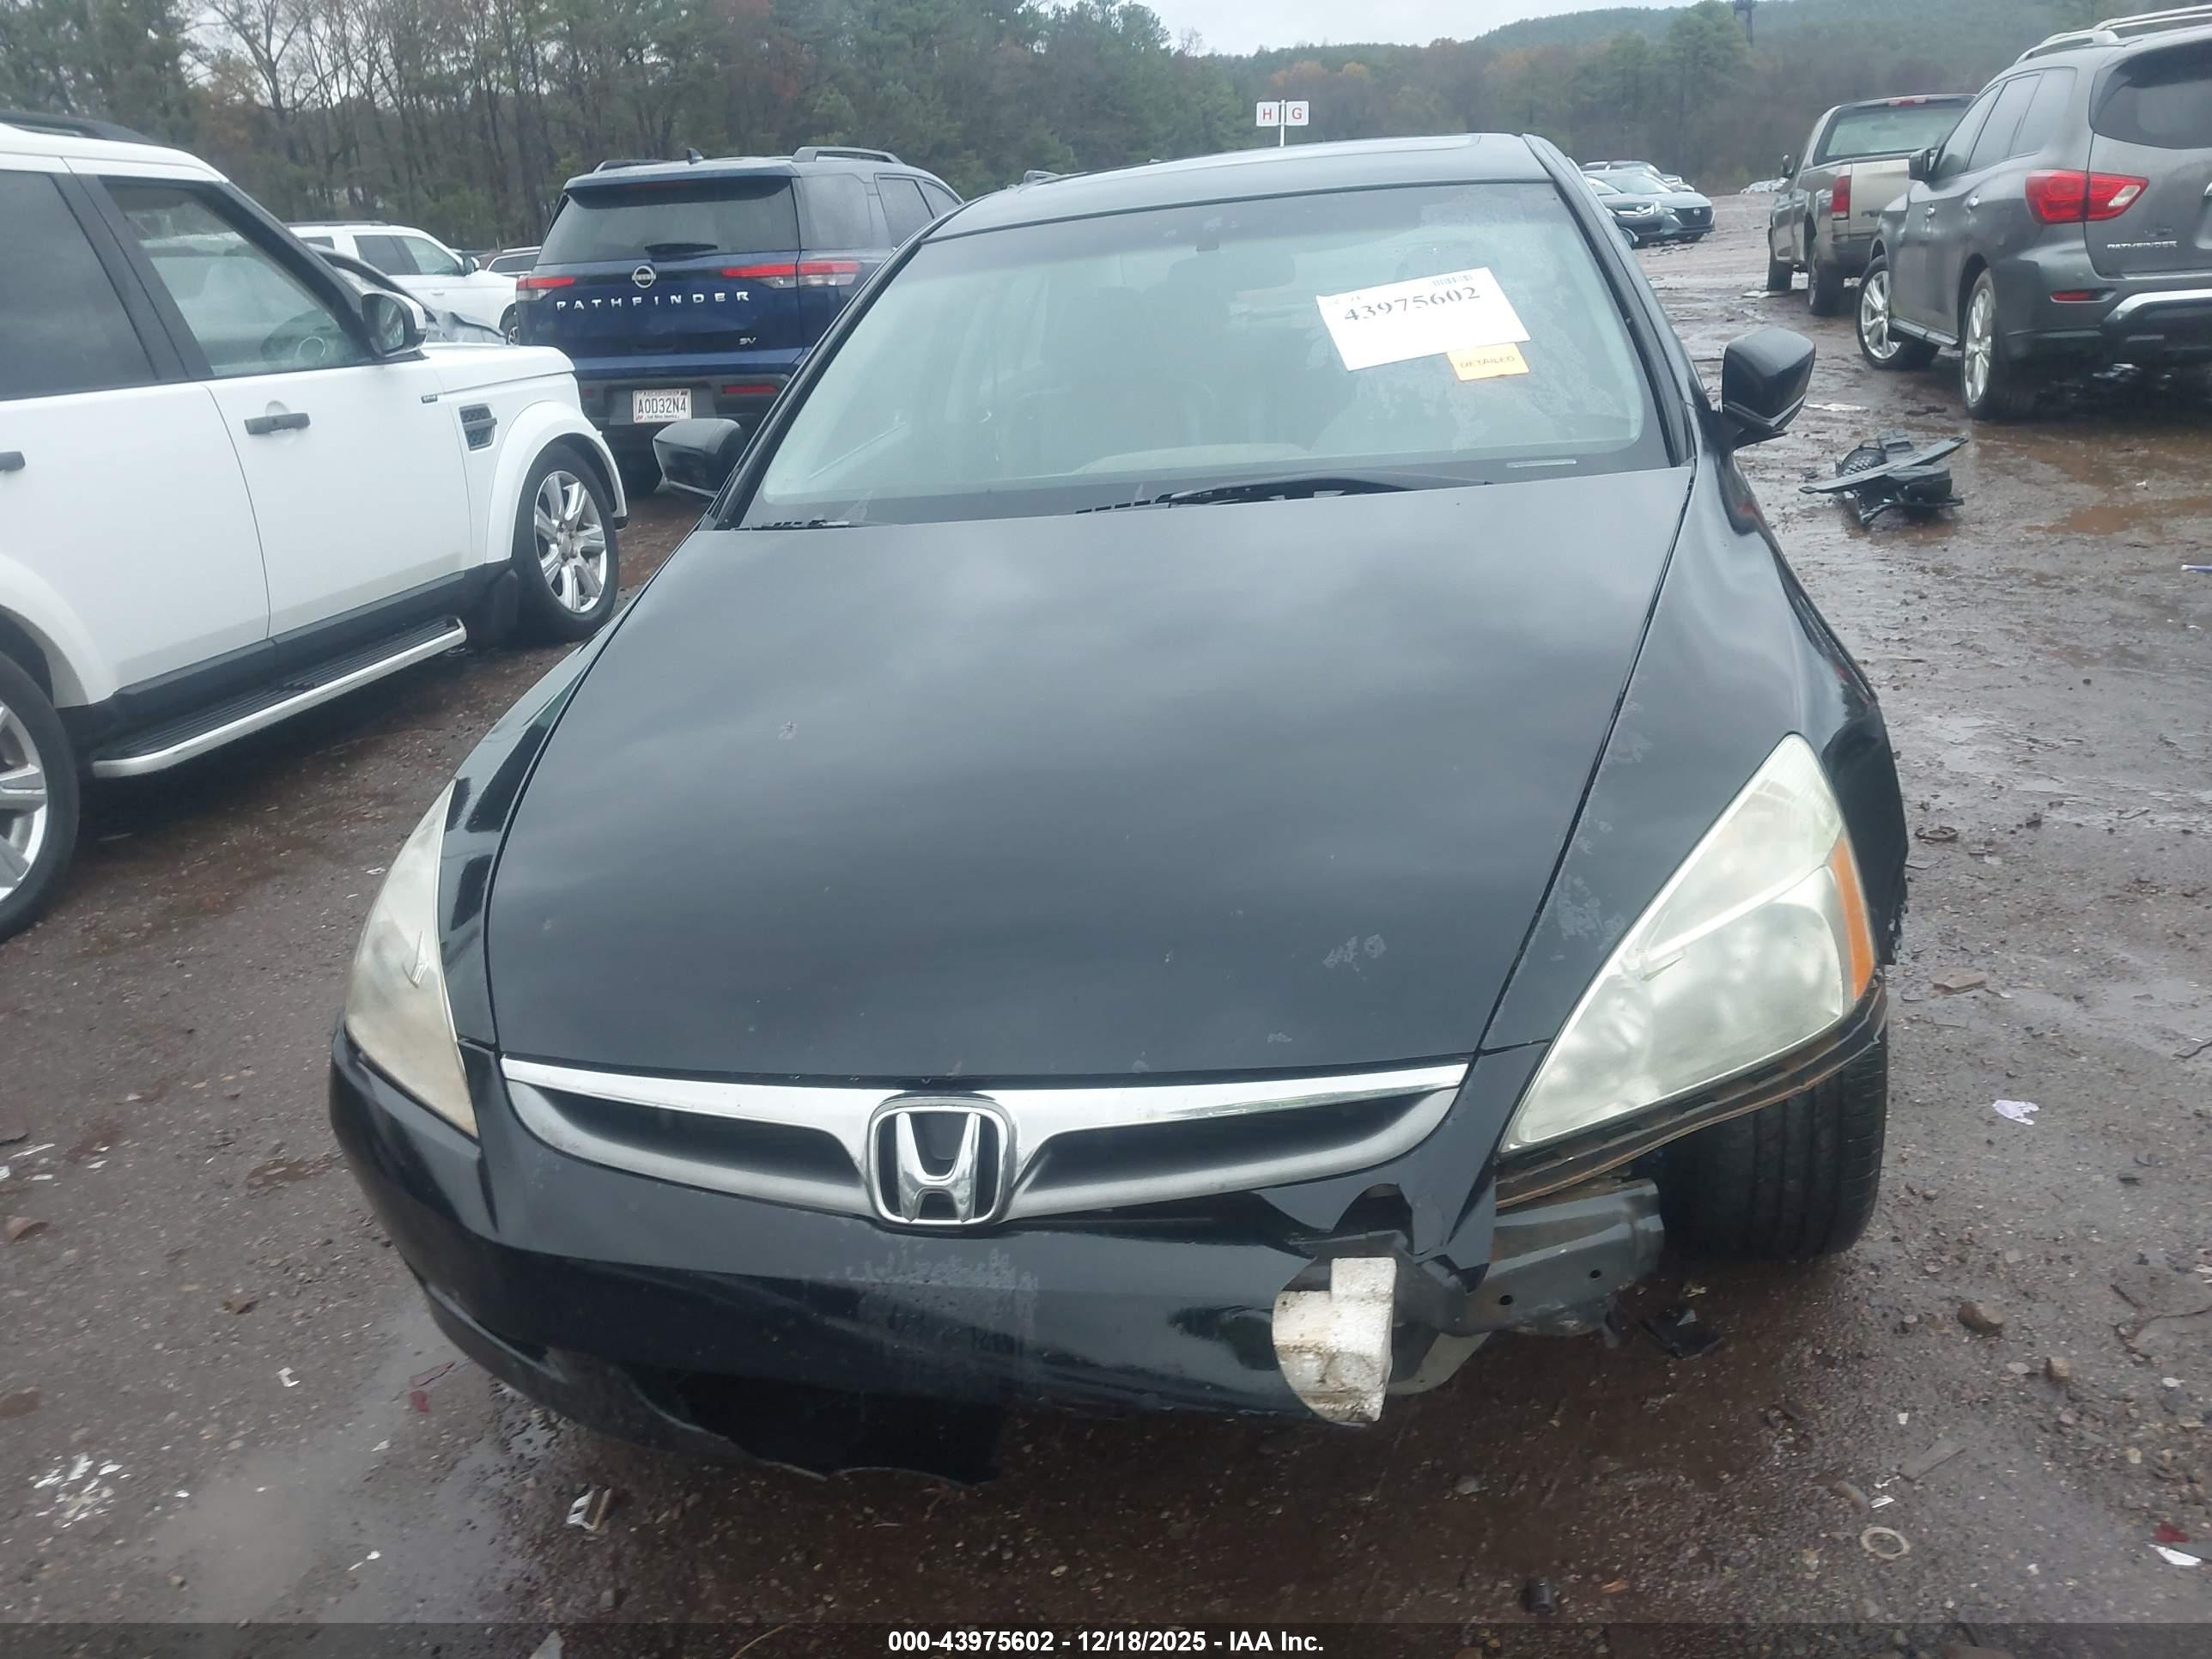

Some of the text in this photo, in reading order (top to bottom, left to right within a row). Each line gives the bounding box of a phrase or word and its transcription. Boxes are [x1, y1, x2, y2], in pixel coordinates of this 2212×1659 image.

[1263, 108, 1272, 120] H
[1291, 107, 1302, 119] G
[556, 290, 750, 311] PATHFINDER
[1344, 286, 1481, 321] 43975602
